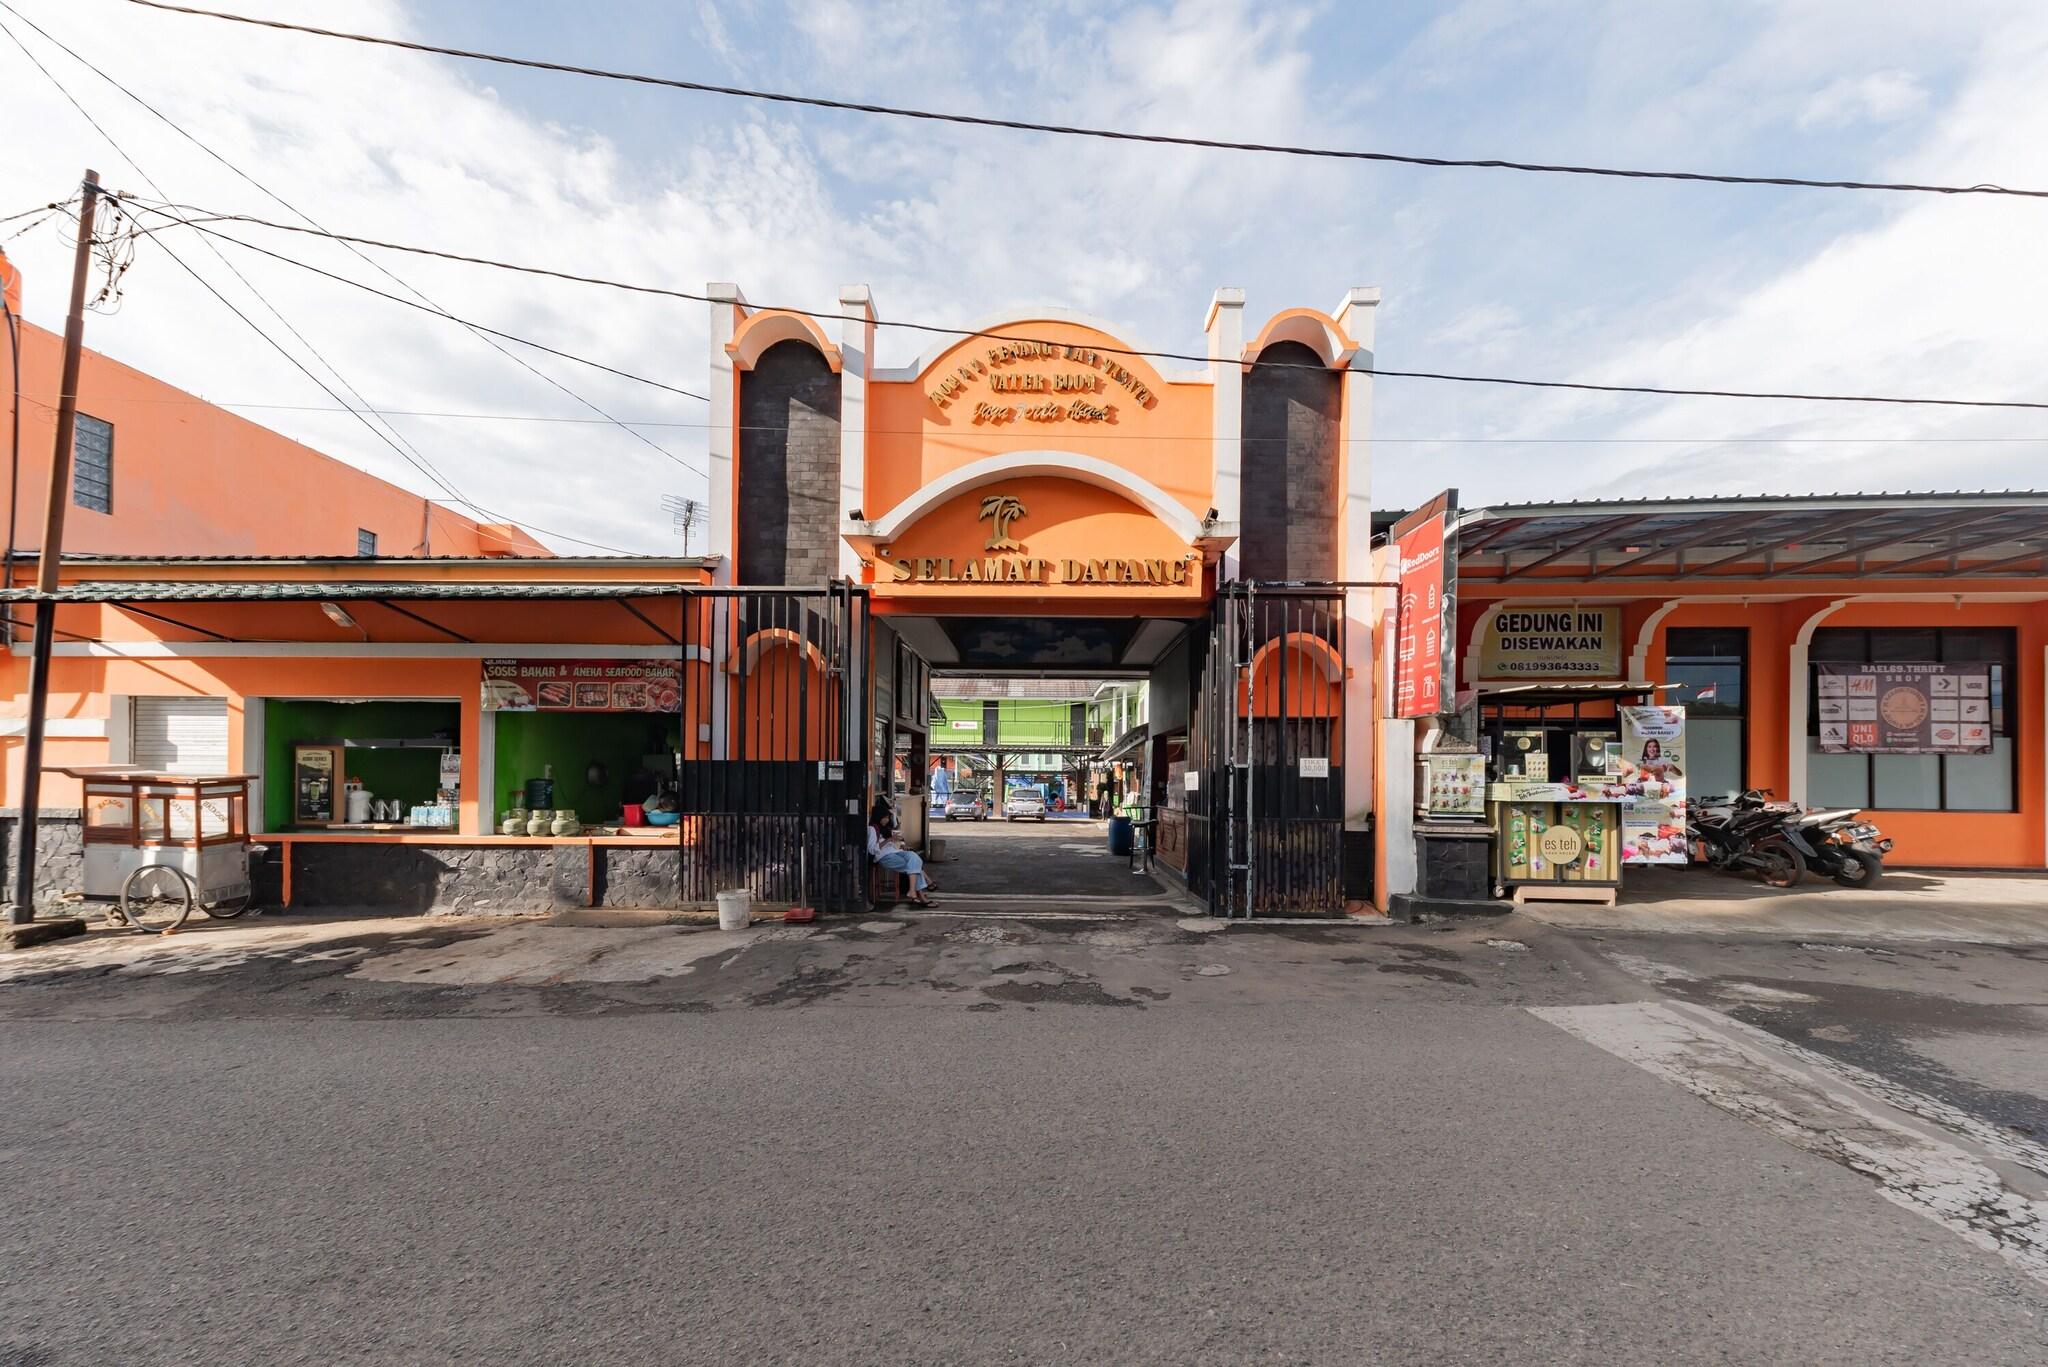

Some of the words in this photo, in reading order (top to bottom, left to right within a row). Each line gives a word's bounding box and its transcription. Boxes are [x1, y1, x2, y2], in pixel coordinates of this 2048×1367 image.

[989, 374, 1045, 391] WATER
[893, 557, 1046, 583] SELAMAT
[1060, 557, 1187, 584] DATANG
[1495, 613, 1572, 633] GEDUNG
[1577, 613, 1602, 632] INI
[1501, 637, 1602, 650] DISEWAKAN
[487, 666, 518, 677] SOSIS
[521, 666, 556, 677] BAKAR
[559, 665, 568, 676] &
[573, 667, 602, 677] ANEKA
[605, 667, 643, 677] SEAFOOD
[645, 667, 675, 677] BAKAR
[1510, 662, 1600, 671] 081993643333
[1886, 674, 1922, 682] SHOP
[1852, 724, 1873, 733] UNI
[1852, 734, 1875, 744] QLO
[1544, 839, 1557, 850] es
[1559, 836, 1577, 850] teh
